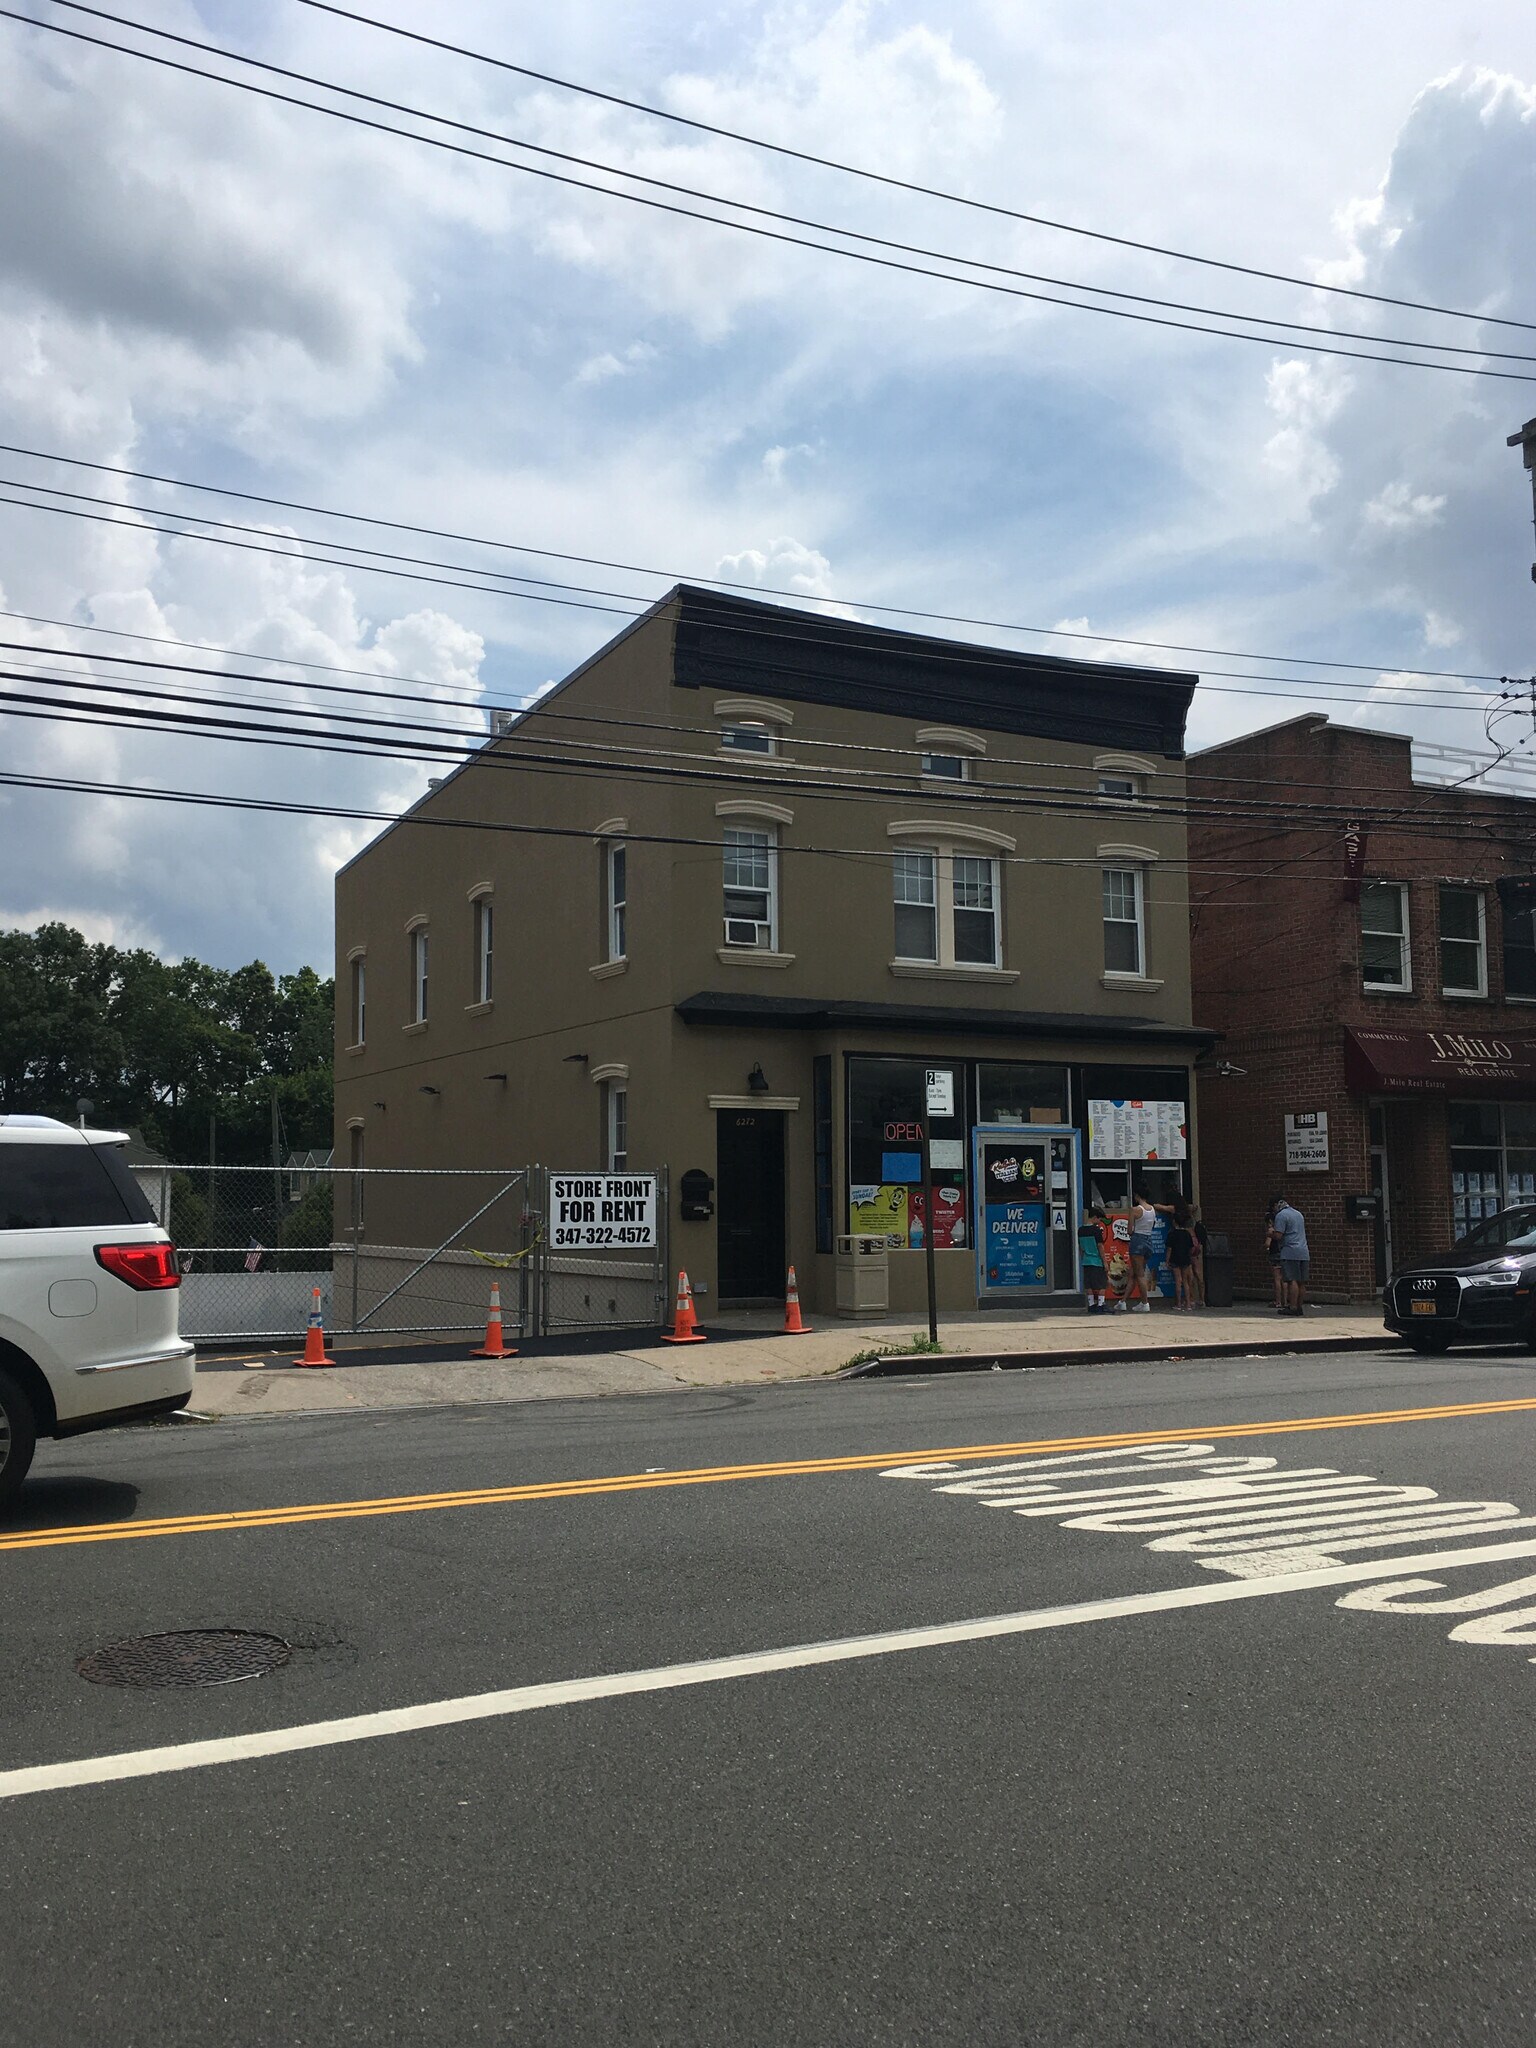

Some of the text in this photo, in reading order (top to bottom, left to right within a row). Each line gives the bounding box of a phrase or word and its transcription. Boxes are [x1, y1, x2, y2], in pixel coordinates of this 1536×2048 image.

[1357, 1032, 1409, 1042] COMMERCIAL
[928, 1072, 934, 1084] 2
[1457, 1067, 1518, 1078] REAL ESTATE
[1407, 1079, 1423, 1088] Real
[1425, 1079, 1446, 1089] Estate
[886, 1123, 924, 1140] OPEN
[555, 1180, 651, 1198] STORE FRONT
[560, 1201, 646, 1222] FOR RENT
[1007, 1208, 1025, 1220] WE
[1054, 1212, 1064, 1226] A
[992, 1221, 1039, 1234] DELIVER!
[556, 1227, 651, 1245] 347-322-4572
